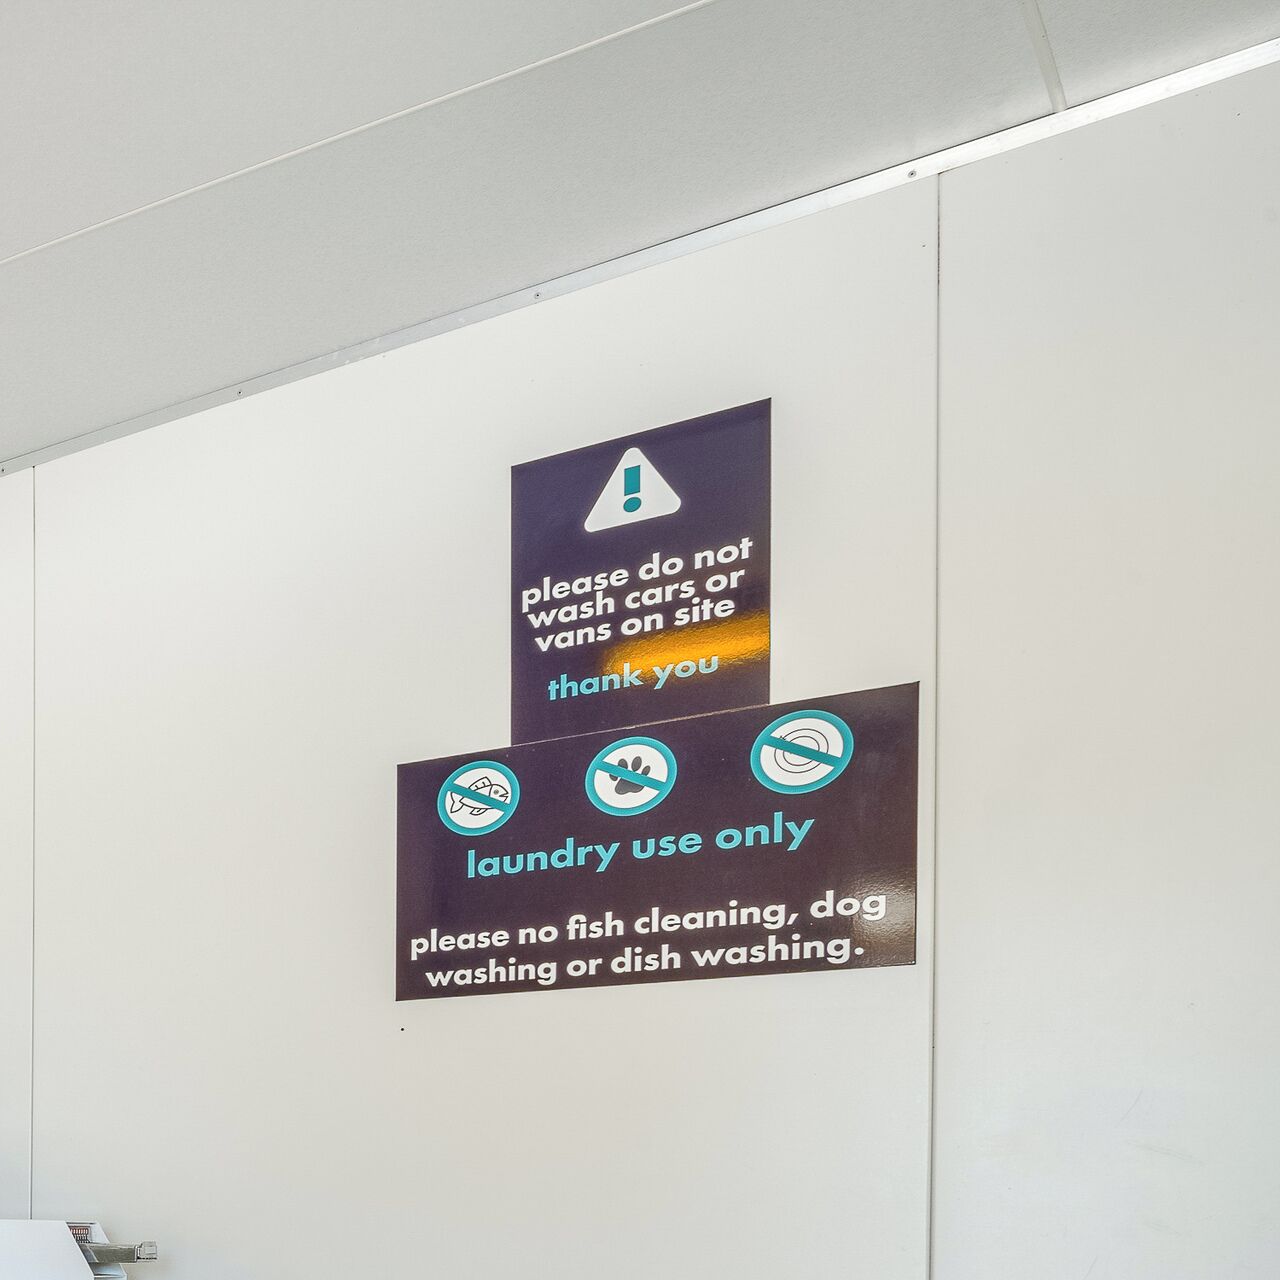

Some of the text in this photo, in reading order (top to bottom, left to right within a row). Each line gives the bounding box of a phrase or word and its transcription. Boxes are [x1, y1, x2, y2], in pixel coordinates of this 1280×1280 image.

[522, 537, 753, 612] please do not
[528, 566, 744, 629] wash cars or
[535, 596, 735, 652] vans on site
[548, 654, 718, 701] thank you
[467, 811, 815, 878] laundry use only
[411, 890, 886, 960] please no fish cleaning, dog
[426, 932, 864, 985] washing or dish washing.
